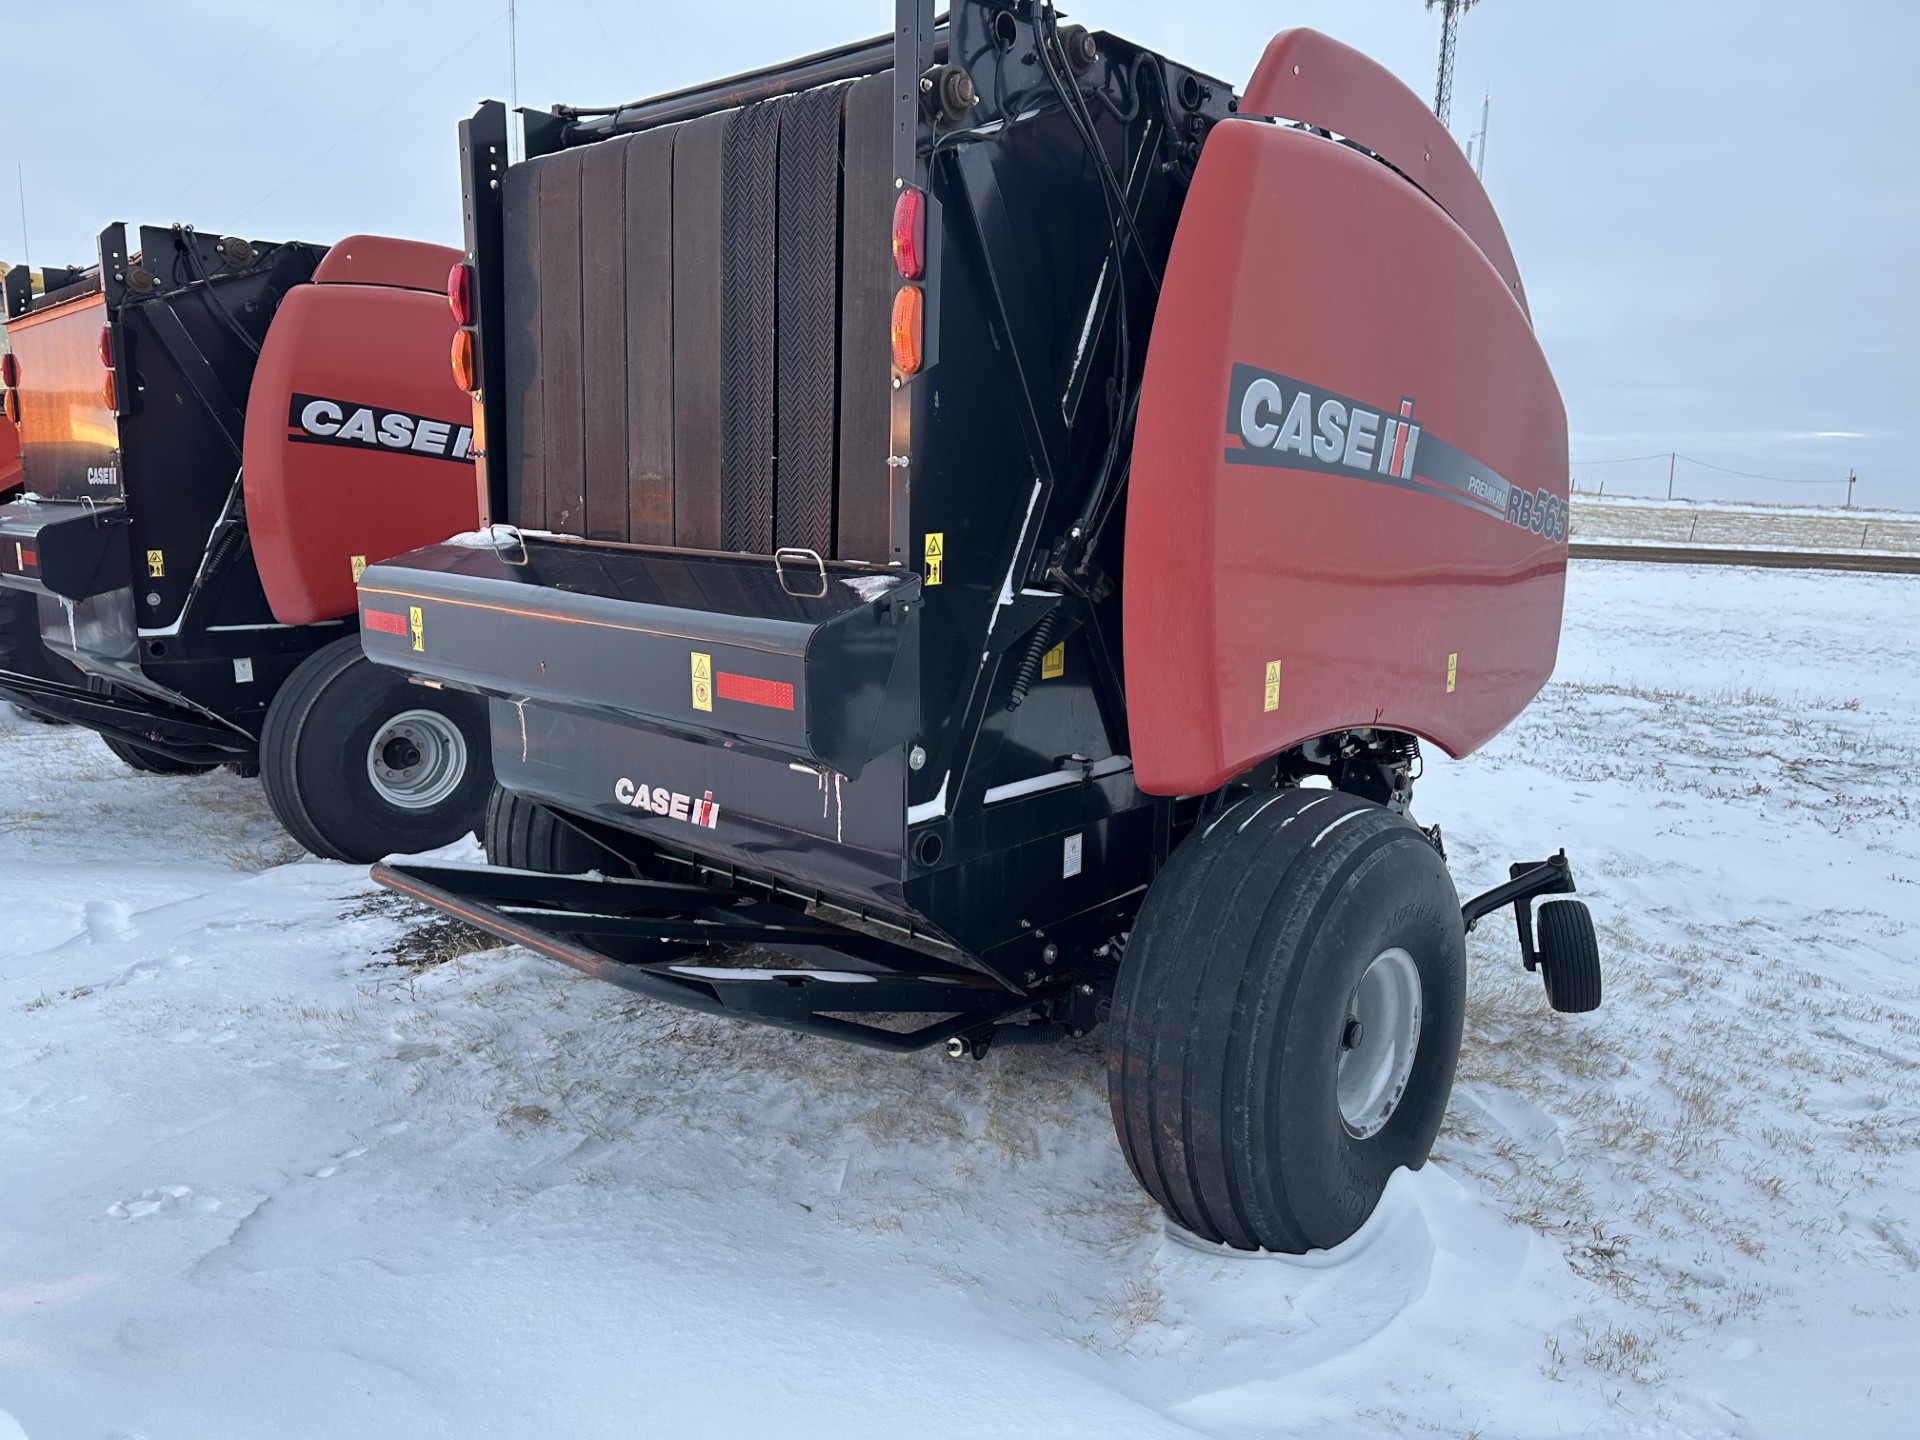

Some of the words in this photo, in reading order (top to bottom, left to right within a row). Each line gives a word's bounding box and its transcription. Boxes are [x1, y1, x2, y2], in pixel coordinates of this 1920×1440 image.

[301, 400, 451, 454] CASE
[1240, 378, 1380, 470] CASE
[87, 466, 109, 485] CASE
[1467, 475, 1507, 510] PREMIUM
[1505, 484, 1569, 544] RB565
[614, 777, 691, 822] CASE
